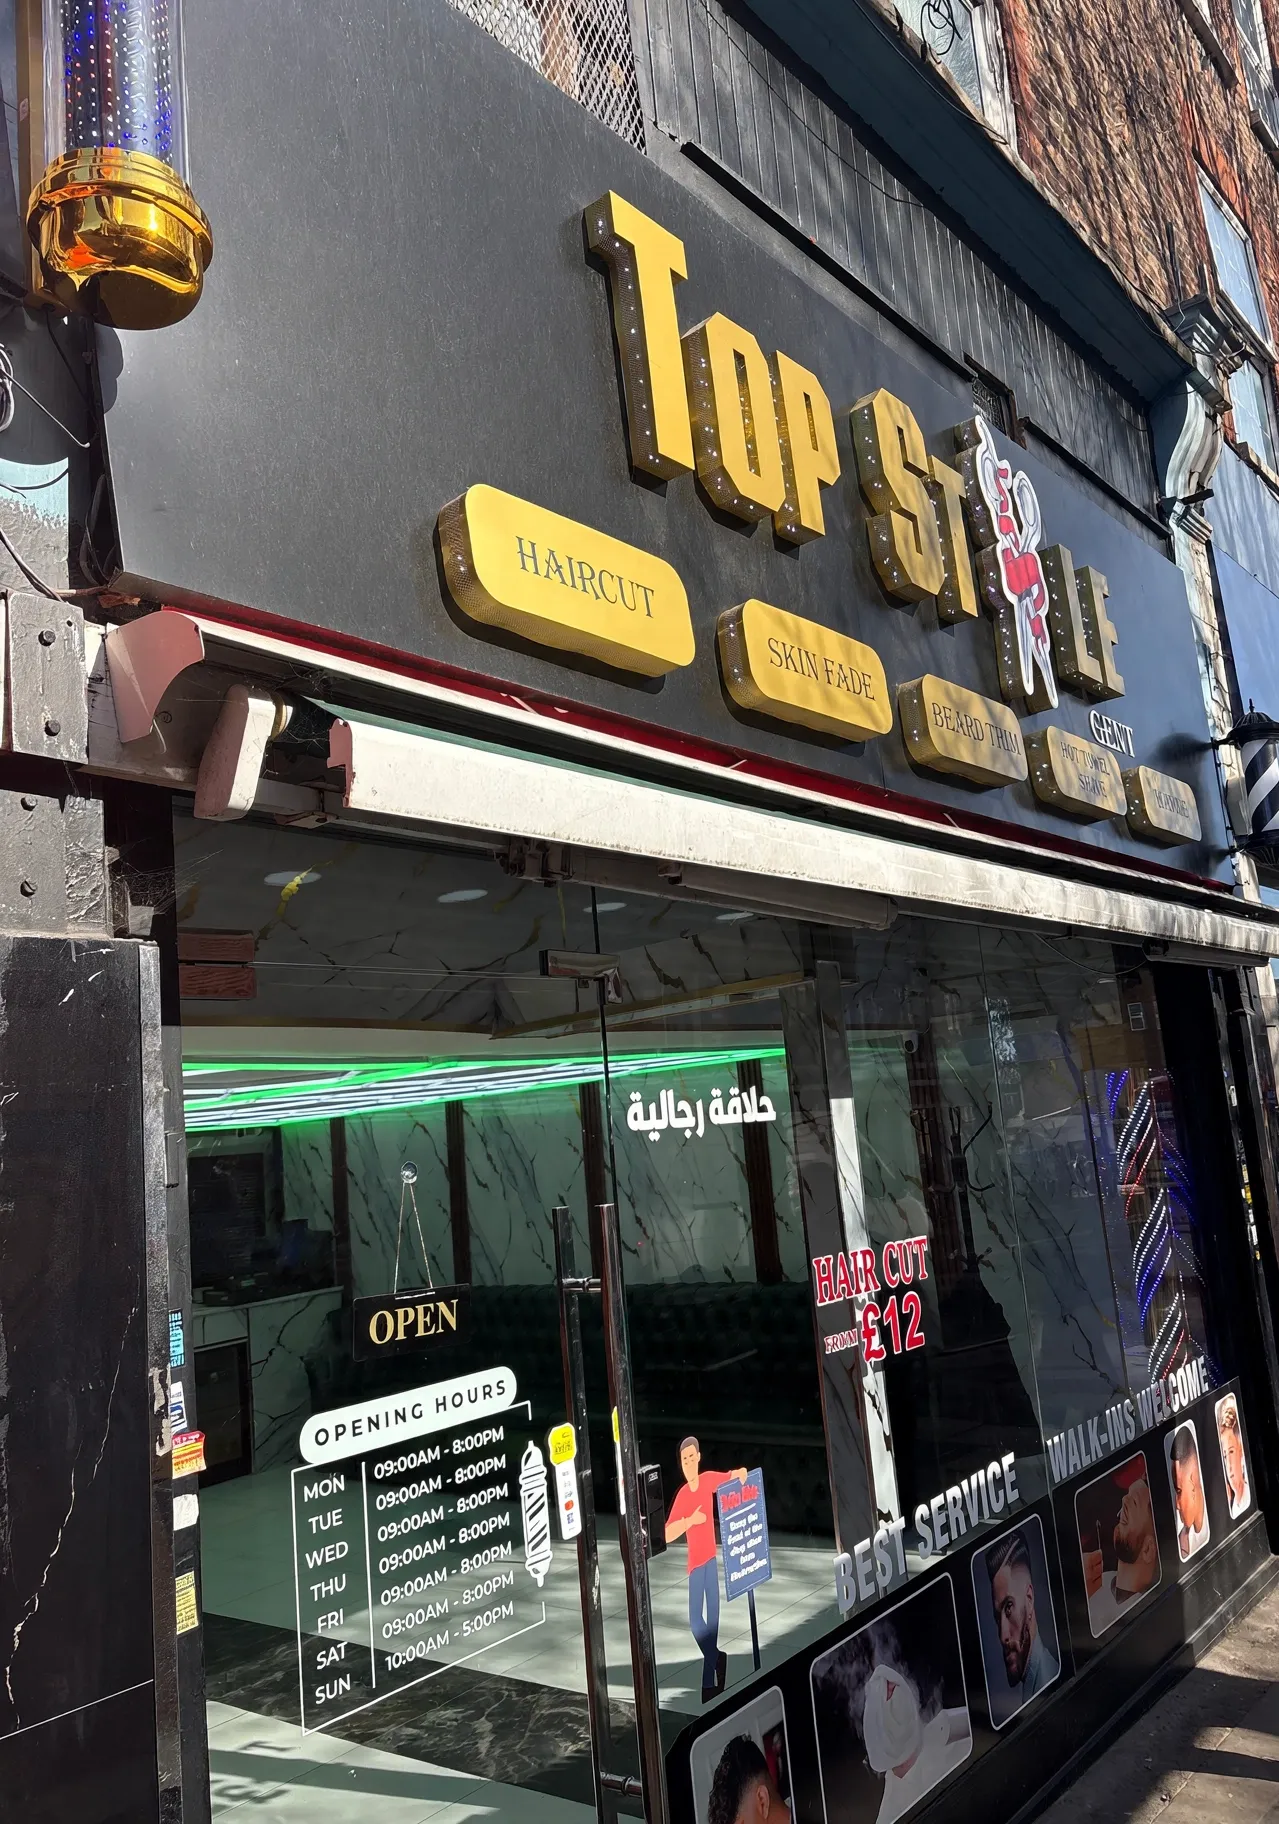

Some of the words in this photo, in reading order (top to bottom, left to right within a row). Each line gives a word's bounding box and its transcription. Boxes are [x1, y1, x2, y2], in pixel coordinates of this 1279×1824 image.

[585, 190, 841, 543] TOP
[514, 535, 655, 619] HAIRCUT
[767, 637, 820, 682] SKIN
[823, 658, 876, 701] FADE
[932, 702, 985, 742] BEARD
[985, 722, 1022, 756] TRIM
[1089, 710, 1136, 758] GENT
[626, 1089, 705, 1142] رجالية
[709, 1086, 776, 1126] حلاقة
[812, 1248, 881, 1307] HAIR
[883, 1235, 928, 1288] CUT
[368, 1299, 458, 1345] OPEN
[861, 1291, 925, 1363] £12
[314, 1403, 423, 1446] OPENING
[435, 1379, 506, 1413] HOURS
[1046, 1398, 1136, 1484] WALK-INS
[1136, 1355, 1209, 1431] WELCOME
[303, 1475, 345, 1502] MON
[374, 1446, 441, 1479] 09:00AM
[452, 1426, 505, 1455] 8:00PM
[308, 1509, 343, 1535] TUE
[376, 1475, 442, 1511] 09:00AM
[454, 1454, 507, 1485] 8:00PM
[305, 1541, 349, 1569] WED
[377, 1506, 444, 1542] 09:00AM
[456, 1483, 509, 1514] 8:00PM
[310, 1574, 347, 1602] THU
[379, 1535, 446, 1574] 09:00AM
[458, 1512, 510, 1545] 8:00PM
[833, 1516, 906, 1615] BEST
[914, 1451, 1020, 1560] SERVICE
[316, 1642, 348, 1671] SAT
[382, 1599, 449, 1639] 09:00AM
[462, 1570, 514, 1605] 8:00PM
[317, 1608, 344, 1634] FRI
[381, 1567, 447, 1606] 09:00AM
[460, 1540, 512, 1575] 8:00PM
[315, 1674, 351, 1705] SUN
[385, 1630, 450, 1671] 10:00AM
[462, 1601, 514, 1637] 5:00PM
